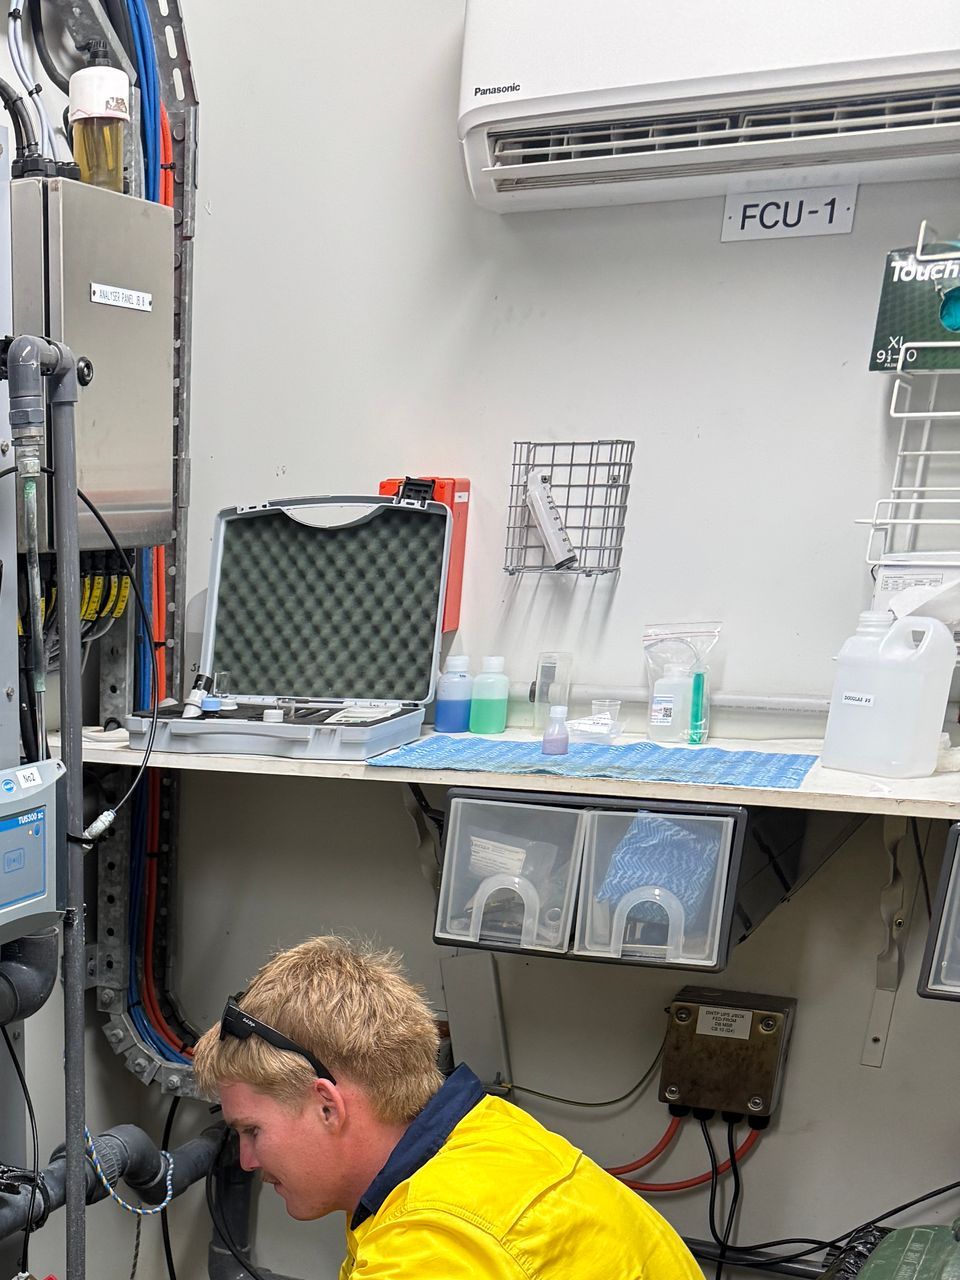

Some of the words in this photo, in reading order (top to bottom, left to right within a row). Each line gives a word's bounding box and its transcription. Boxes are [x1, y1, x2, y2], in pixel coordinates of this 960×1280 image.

[474, 82, 521, 96] Panasonic
[739, 197, 838, 230] FCU-1
[23, 772, 36, 783] No2
[18, 813, 37, 825] TU5300
